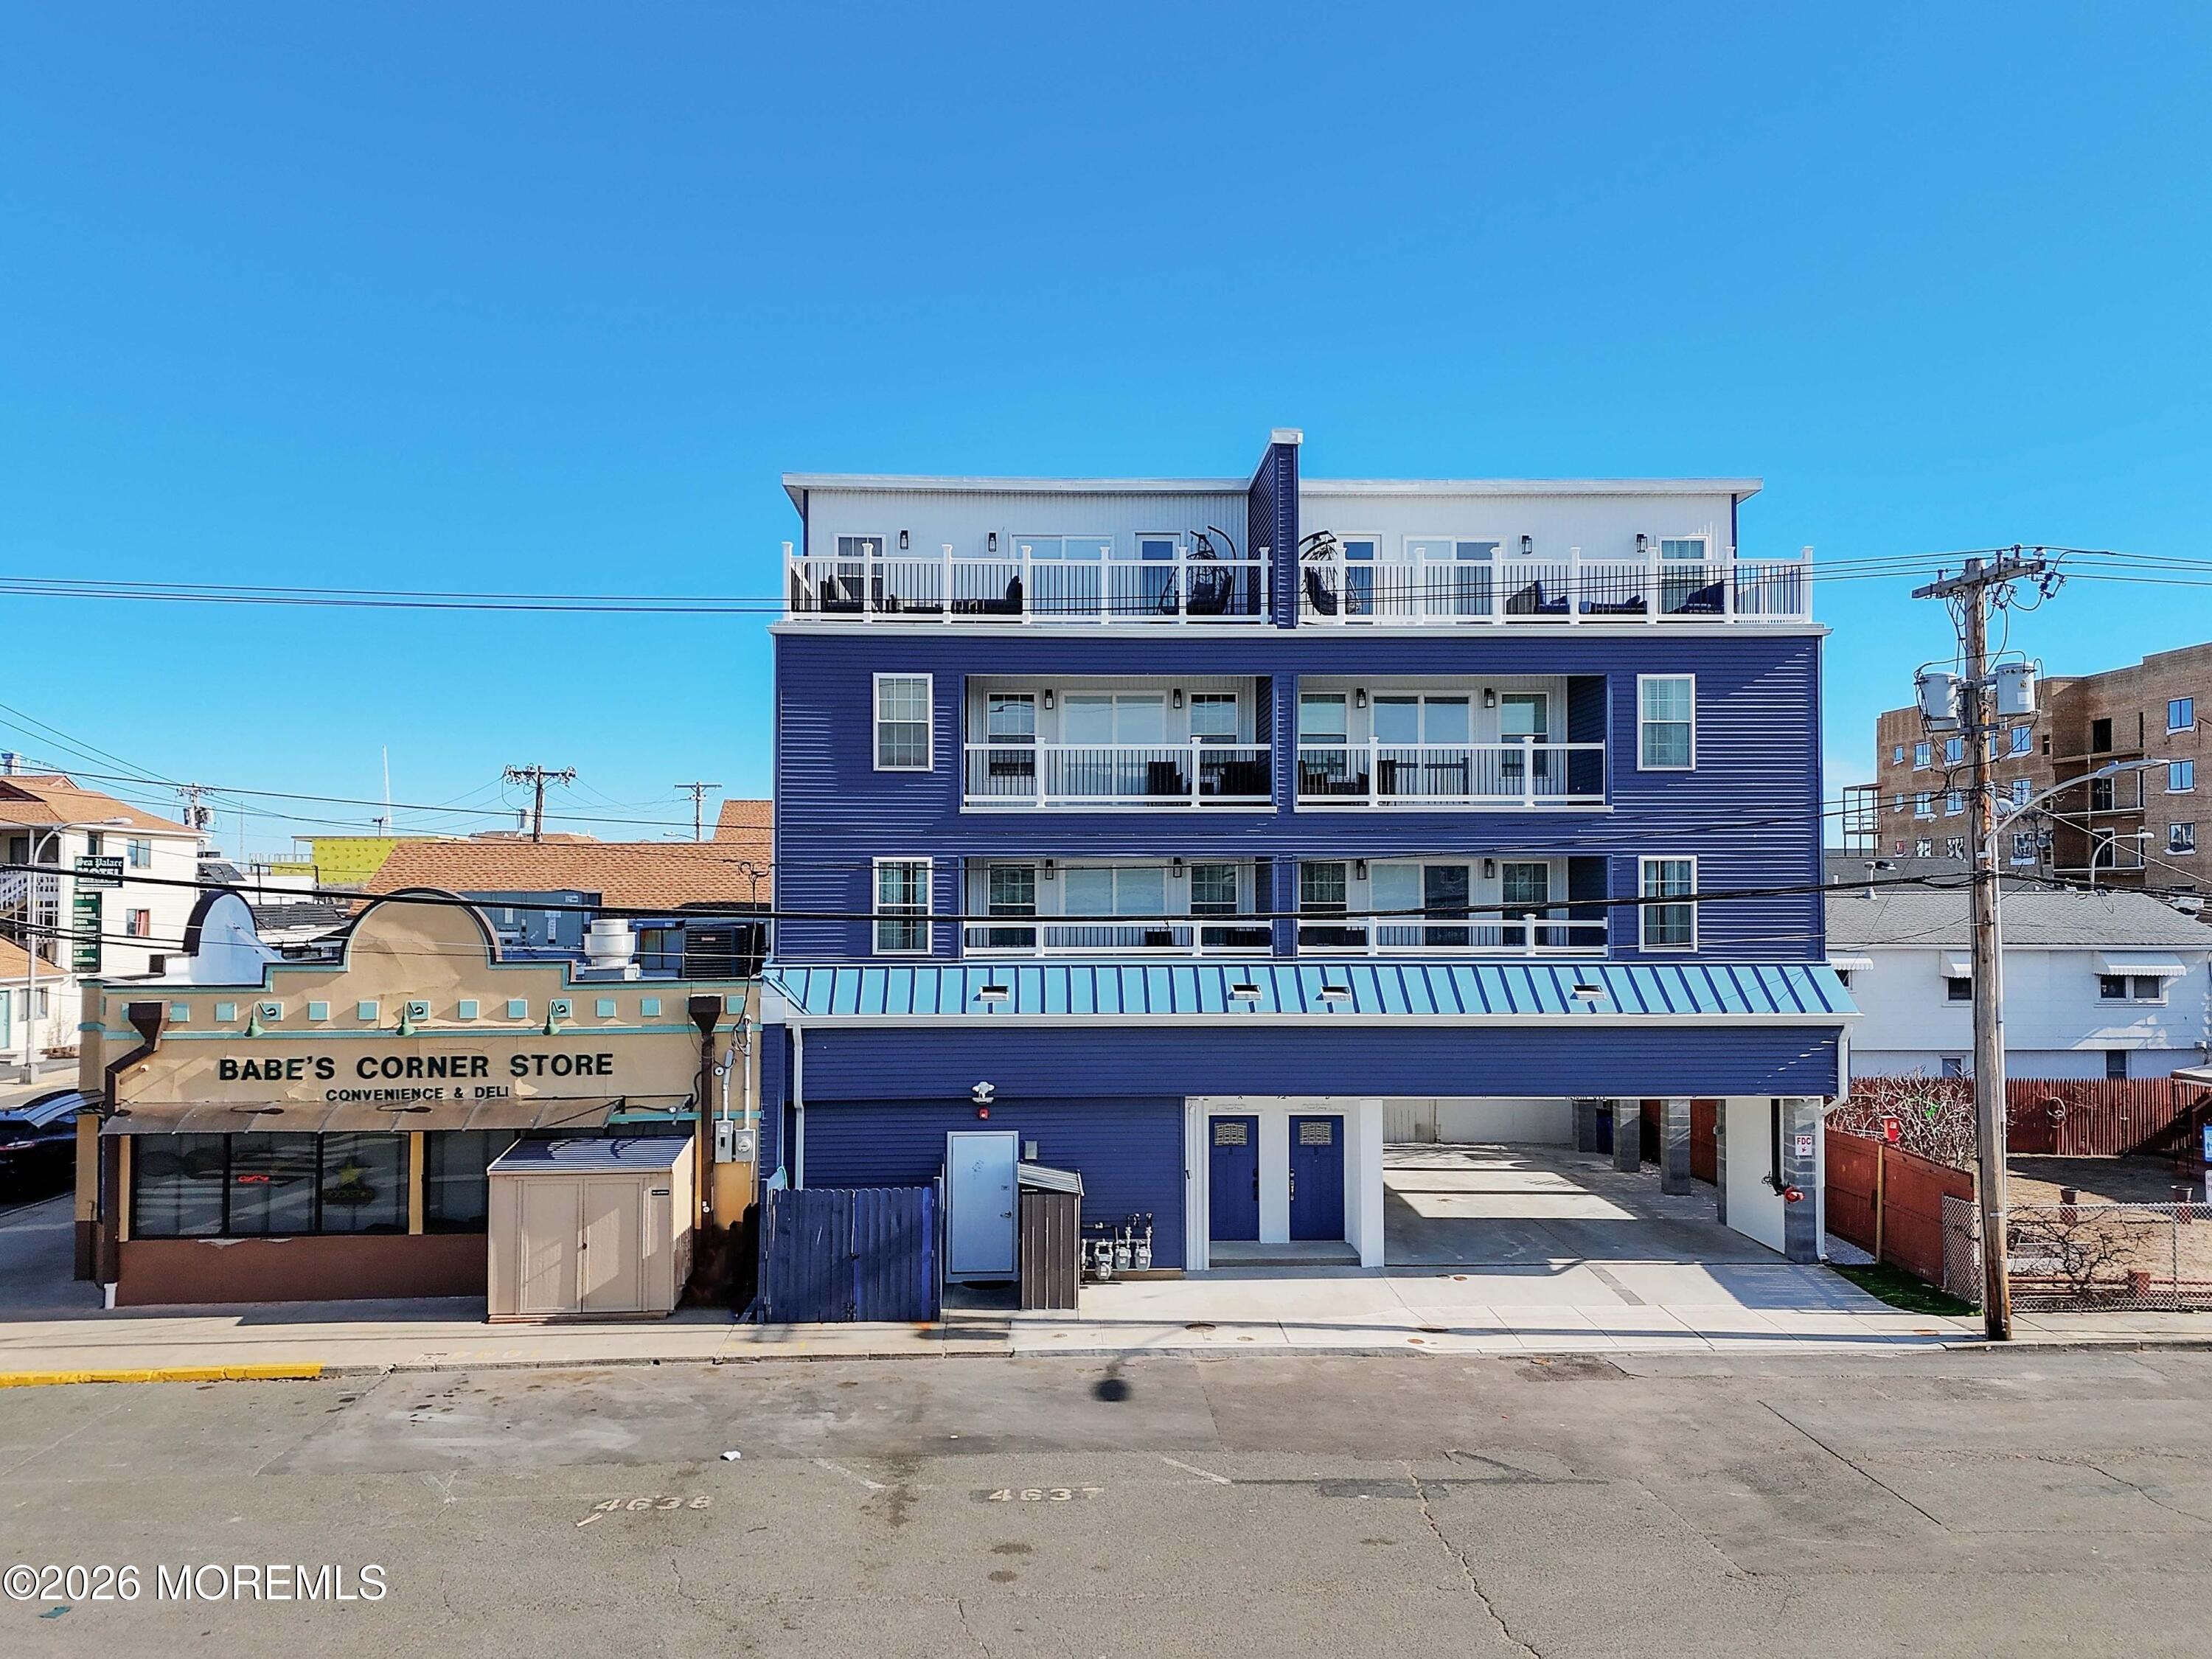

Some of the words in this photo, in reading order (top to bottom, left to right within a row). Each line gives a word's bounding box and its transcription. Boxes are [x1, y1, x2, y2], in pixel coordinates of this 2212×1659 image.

[76, 858, 93, 866] Sea
[94, 858, 122, 868] Palace
[219, 1056, 335, 1080] BABE'S
[356, 1056, 489, 1079] CORNER
[509, 1053, 613, 1077] STORE
[325, 1088, 444, 1102] CONVENIENCE
[453, 1087, 464, 1099] &
[474, 1086, 509, 1099] DELI
[1796, 1137, 1812, 1145] FDC
[324, 1189, 372, 1199] ROCKSTR
[988, 1486, 1105, 1502] 4637
[594, 1495, 710, 1512] 4638
